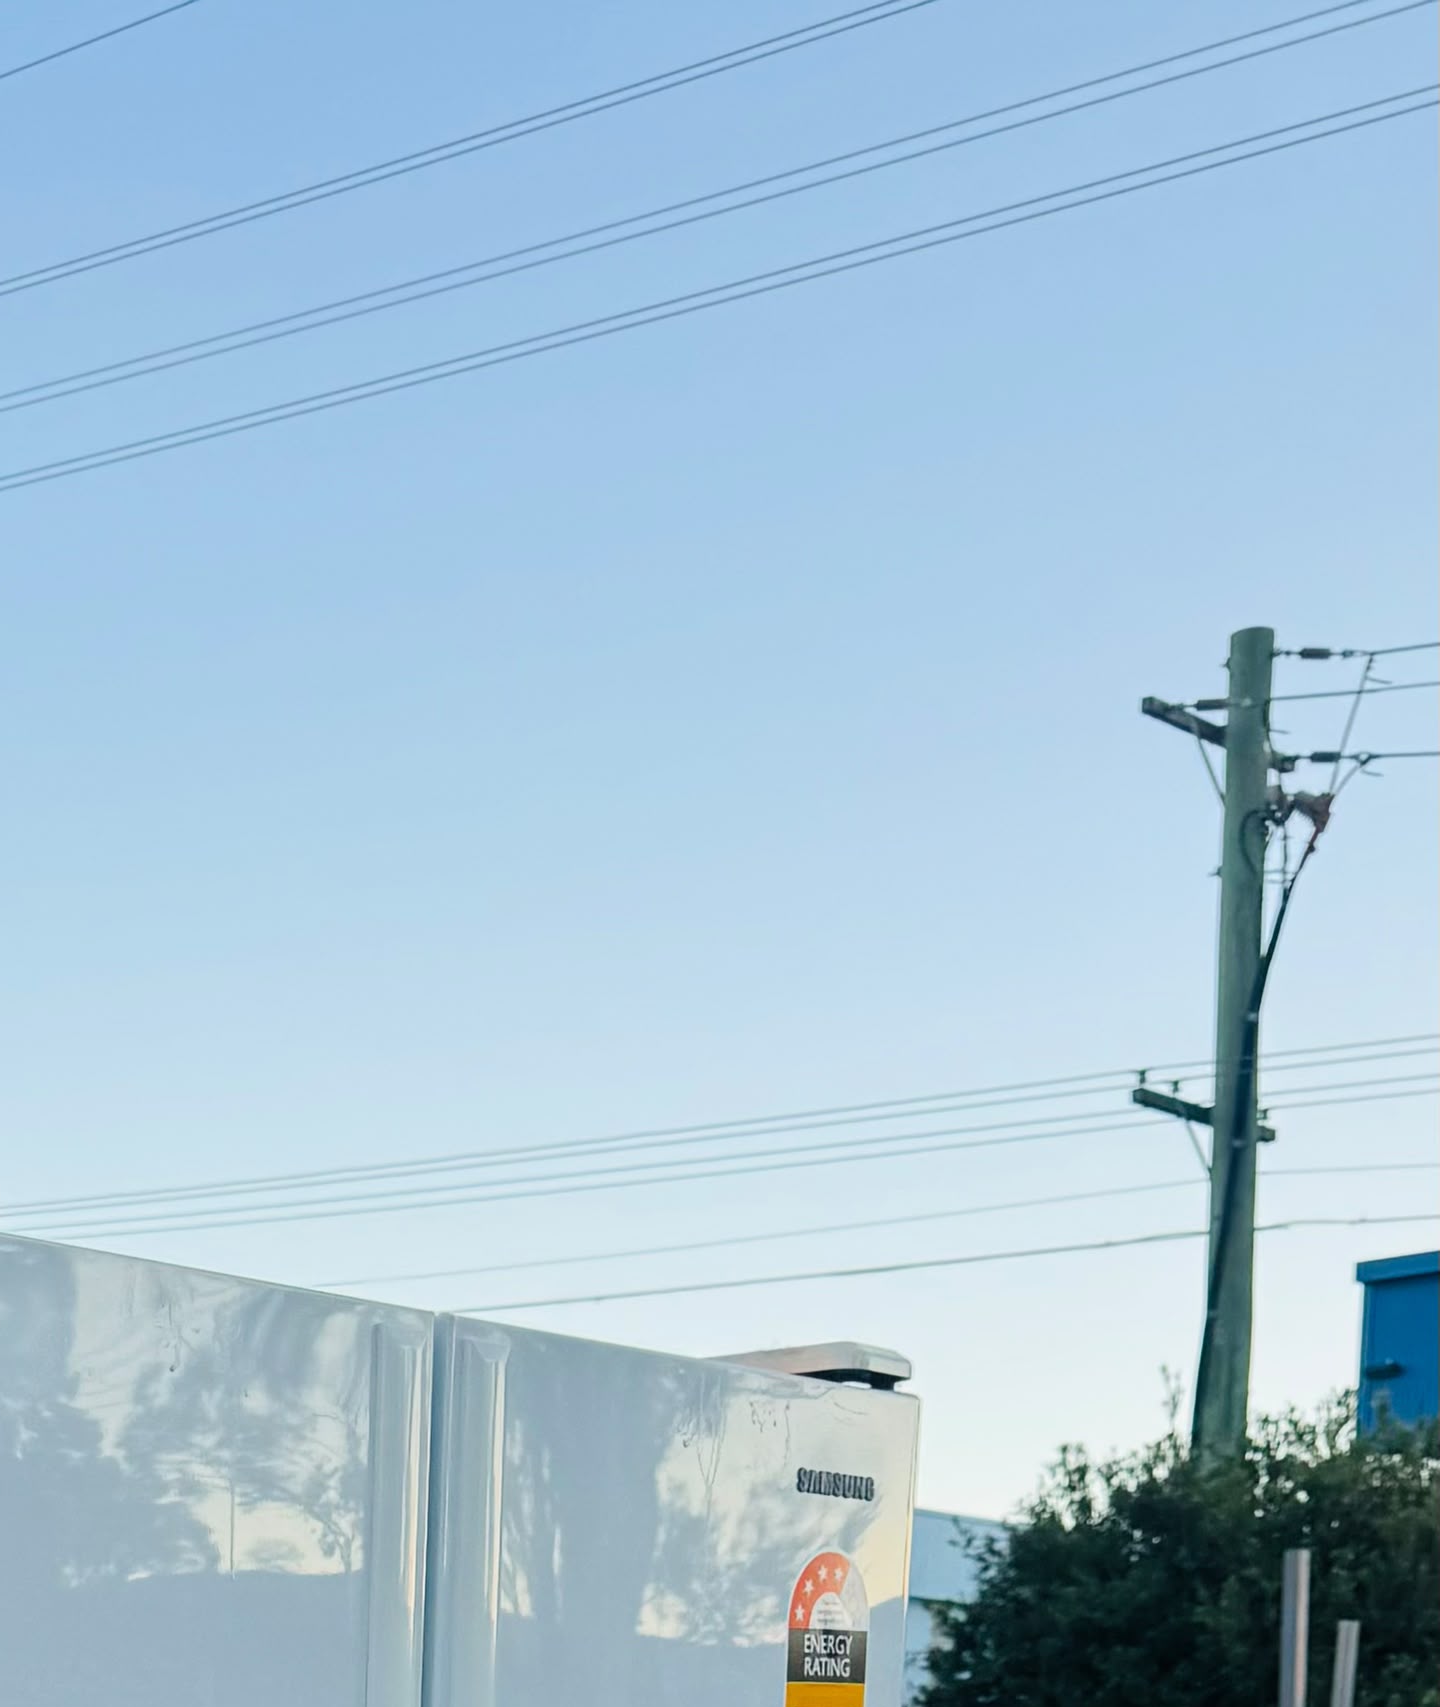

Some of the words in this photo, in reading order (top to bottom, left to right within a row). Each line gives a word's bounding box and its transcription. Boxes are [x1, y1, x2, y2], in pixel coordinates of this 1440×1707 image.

[796, 1467, 875, 1502] SAMSUNG
[804, 1633, 853, 1655] ENERGY
[804, 1656, 850, 1677] RATING
